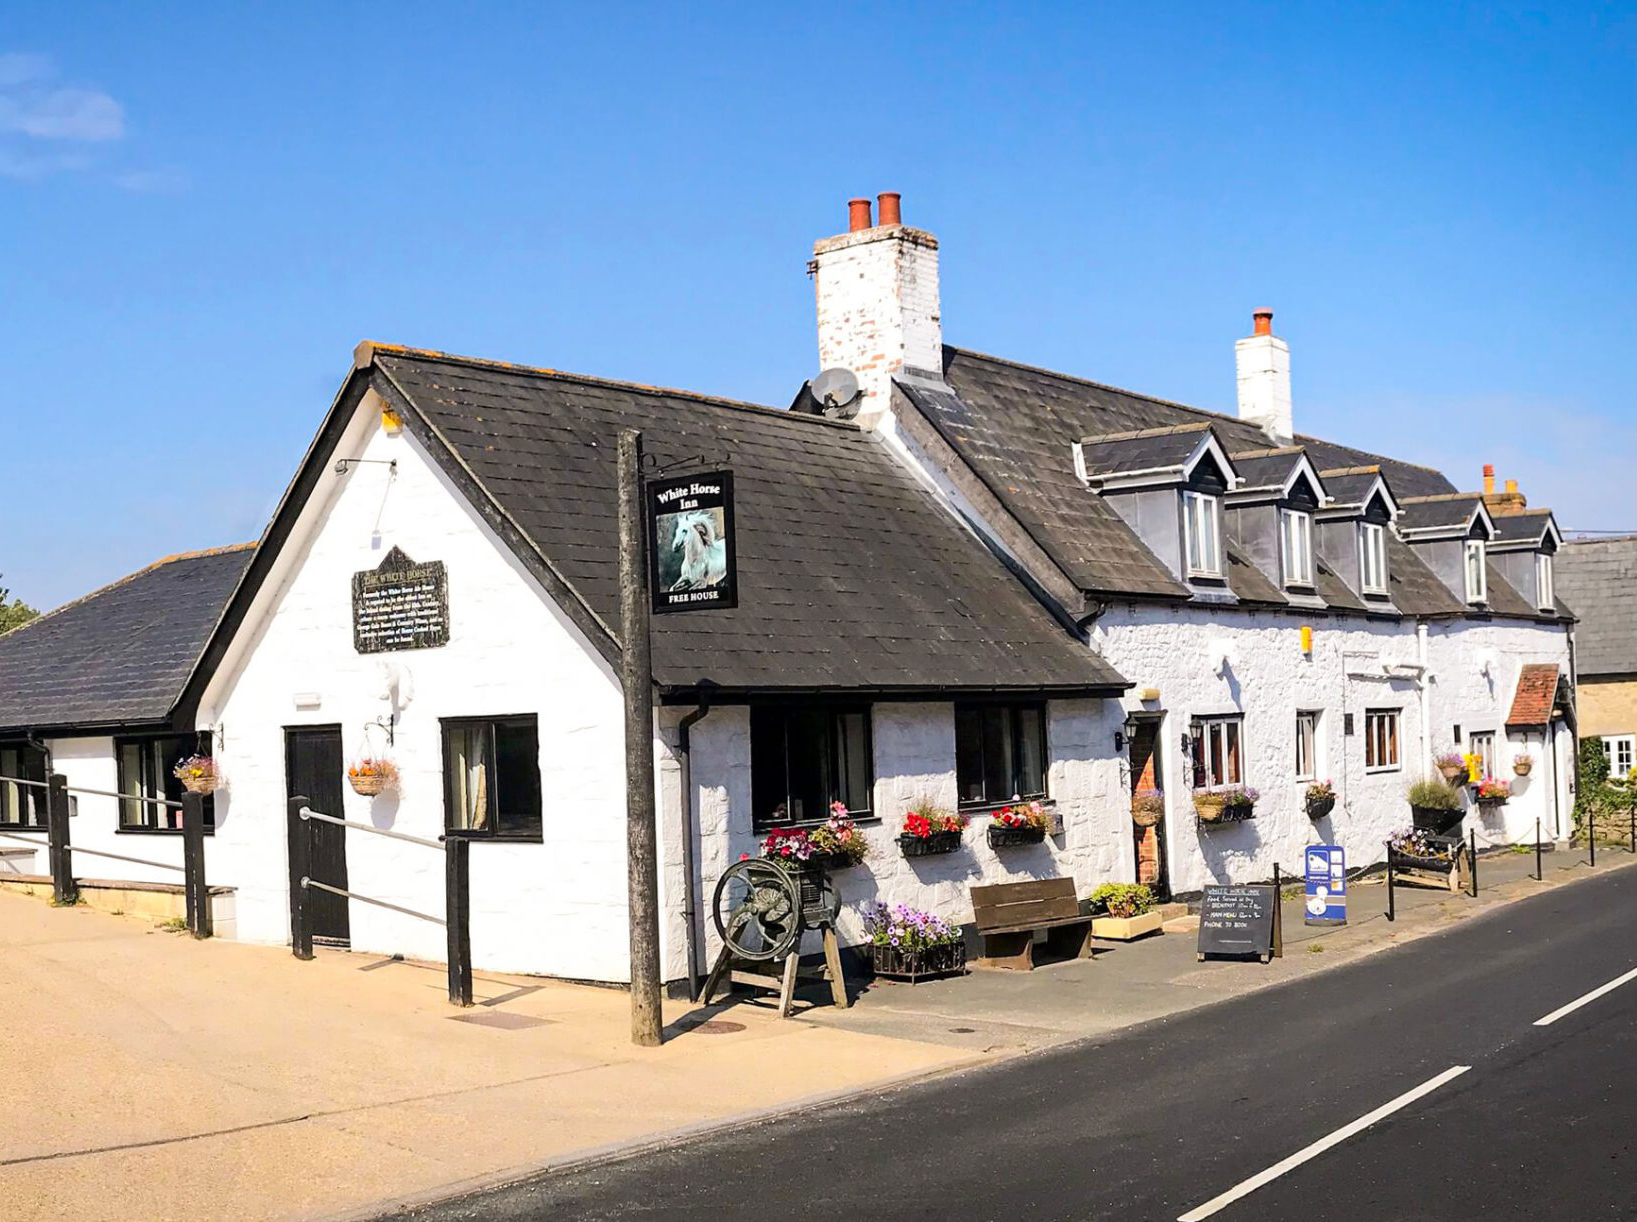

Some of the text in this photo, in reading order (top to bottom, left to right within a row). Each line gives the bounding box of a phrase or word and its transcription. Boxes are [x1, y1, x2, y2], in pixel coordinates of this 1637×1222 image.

[657, 484, 720, 504] White Horse
[680, 499, 698, 510] Inn
[381, 573, 407, 583] WHITE
[407, 569, 432, 580] HORSE
[669, 591, 718, 603] FREE HOUSE
